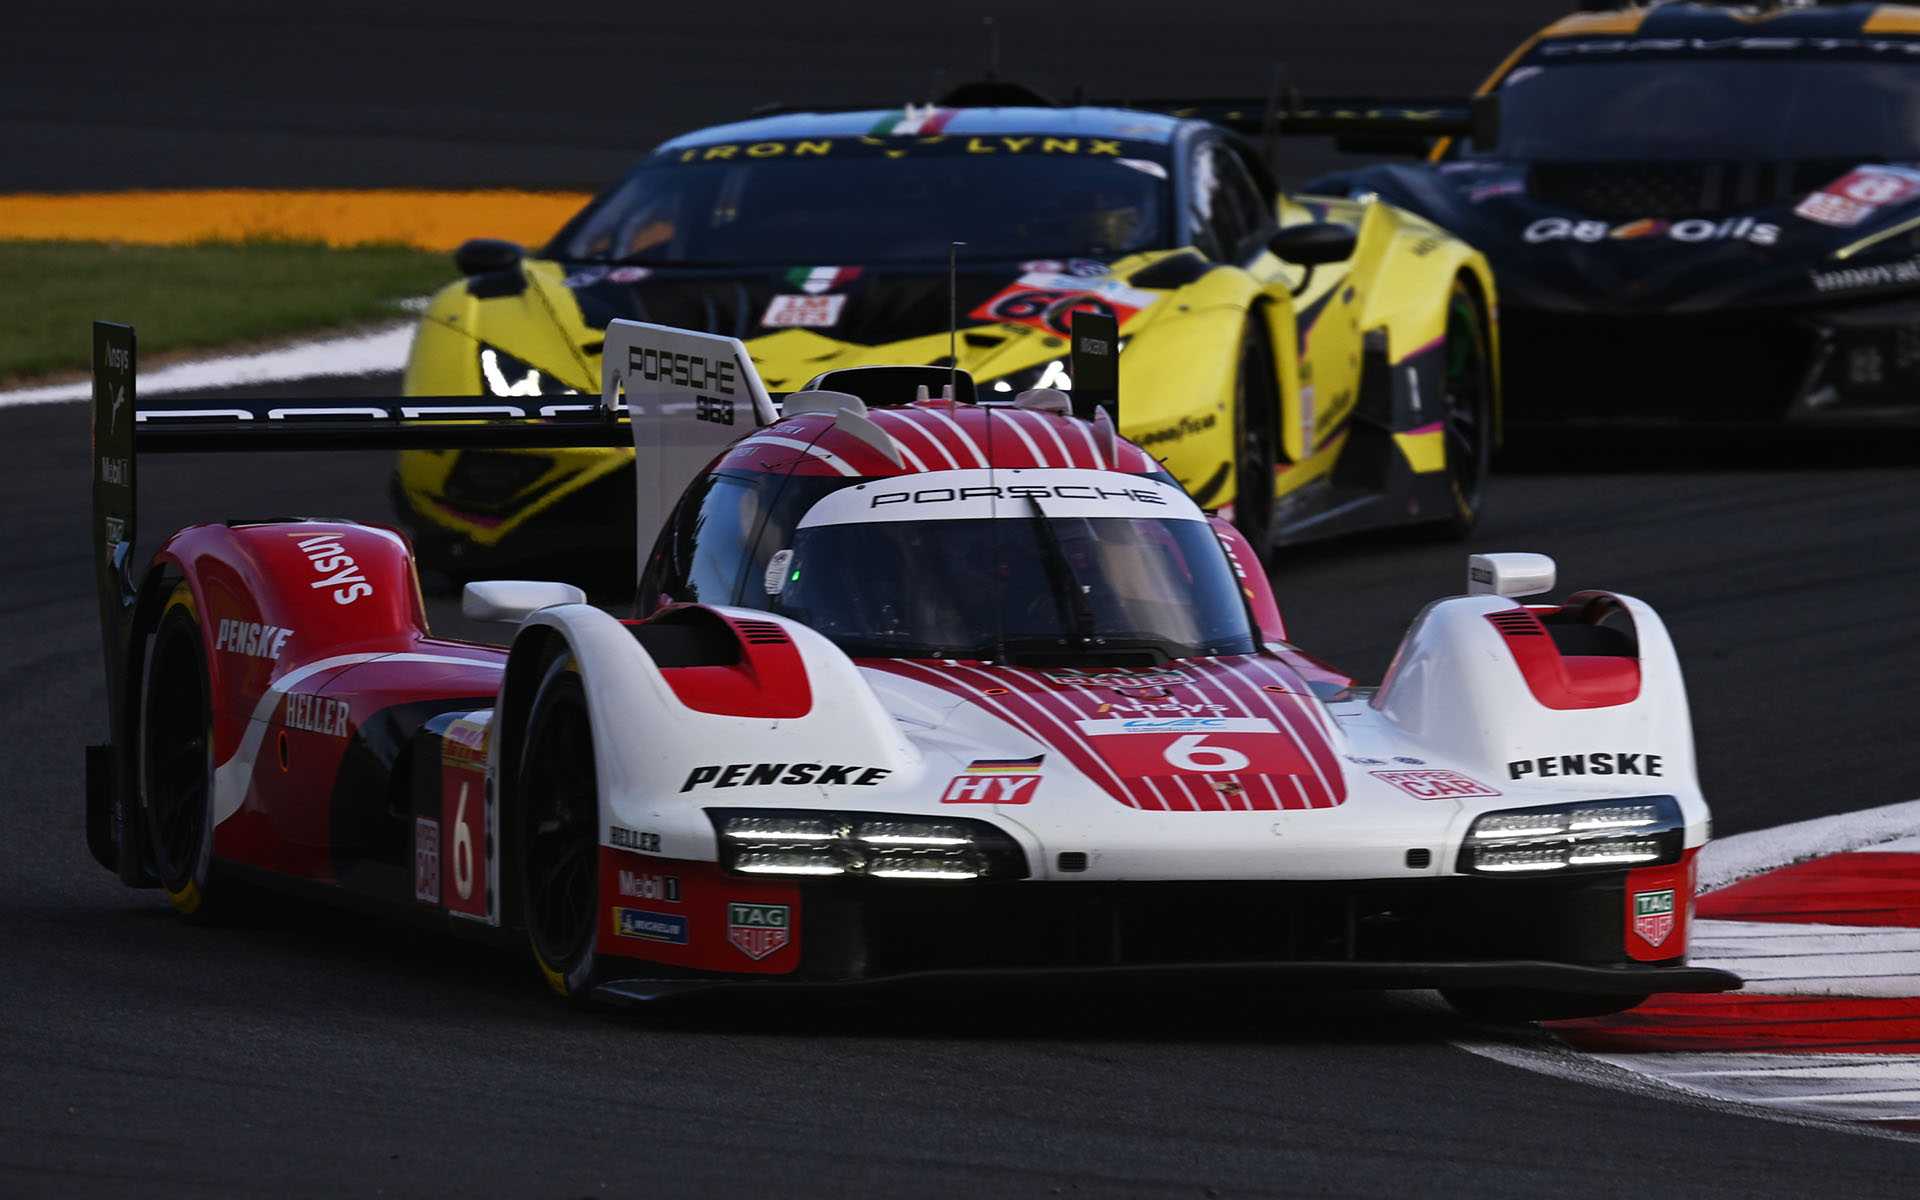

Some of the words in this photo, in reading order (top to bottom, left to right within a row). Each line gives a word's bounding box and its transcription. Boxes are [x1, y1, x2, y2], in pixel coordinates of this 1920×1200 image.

[680, 141, 834, 163] IRON
[964, 138, 1122, 156] LYNX
[1522, 217, 1608, 243] Q8
[1668, 217, 1781, 245] Oils
[629, 346, 734, 394] PORSCHE
[696, 395, 734, 425] 963
[871, 486, 1167, 508] PORSCHE
[287, 533, 374, 605] Ansys
[216, 618, 295, 660] PENSKE
[286, 692, 350, 738] HELLER
[1097, 702, 1230, 713] Ansys
[1163, 734, 1250, 772] 6
[1509, 753, 1664, 780] PENSKE
[680, 763, 893, 793] PENSKE
[944, 776, 1035, 800] HY
[1403, 780, 1491, 796] CAR
[453, 781, 474, 900] 6
[610, 826, 661, 853] HELLER
[618, 869, 664, 900] Mobil
[734, 907, 784, 926] TAG
[1637, 894, 1673, 913] TAG
[731, 927, 786, 956] HEUER
